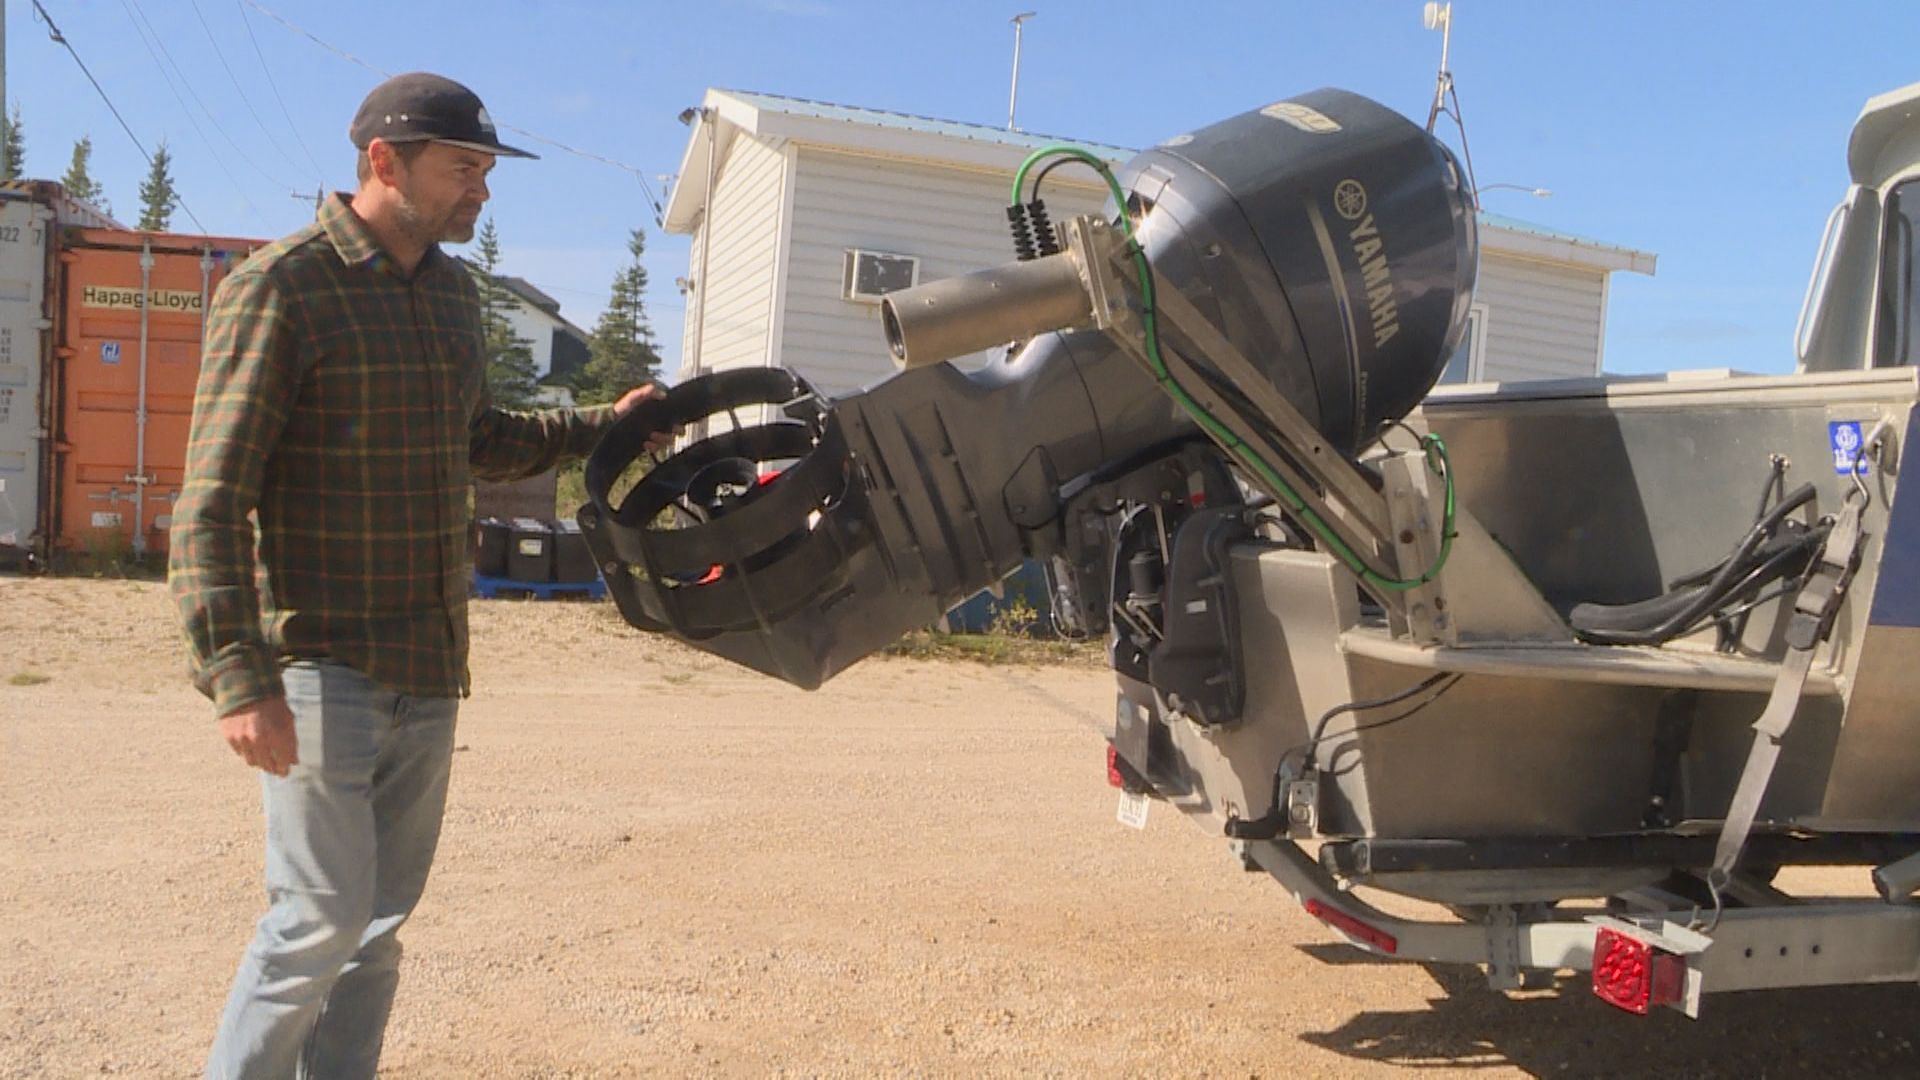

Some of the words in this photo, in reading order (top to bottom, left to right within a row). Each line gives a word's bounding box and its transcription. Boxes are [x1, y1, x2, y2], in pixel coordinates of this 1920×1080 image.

[0, 226, 20, 242] 22
[1350, 213, 1399, 348] YAMAHA
[83, 287, 203, 310] Hapag-Lloyd
